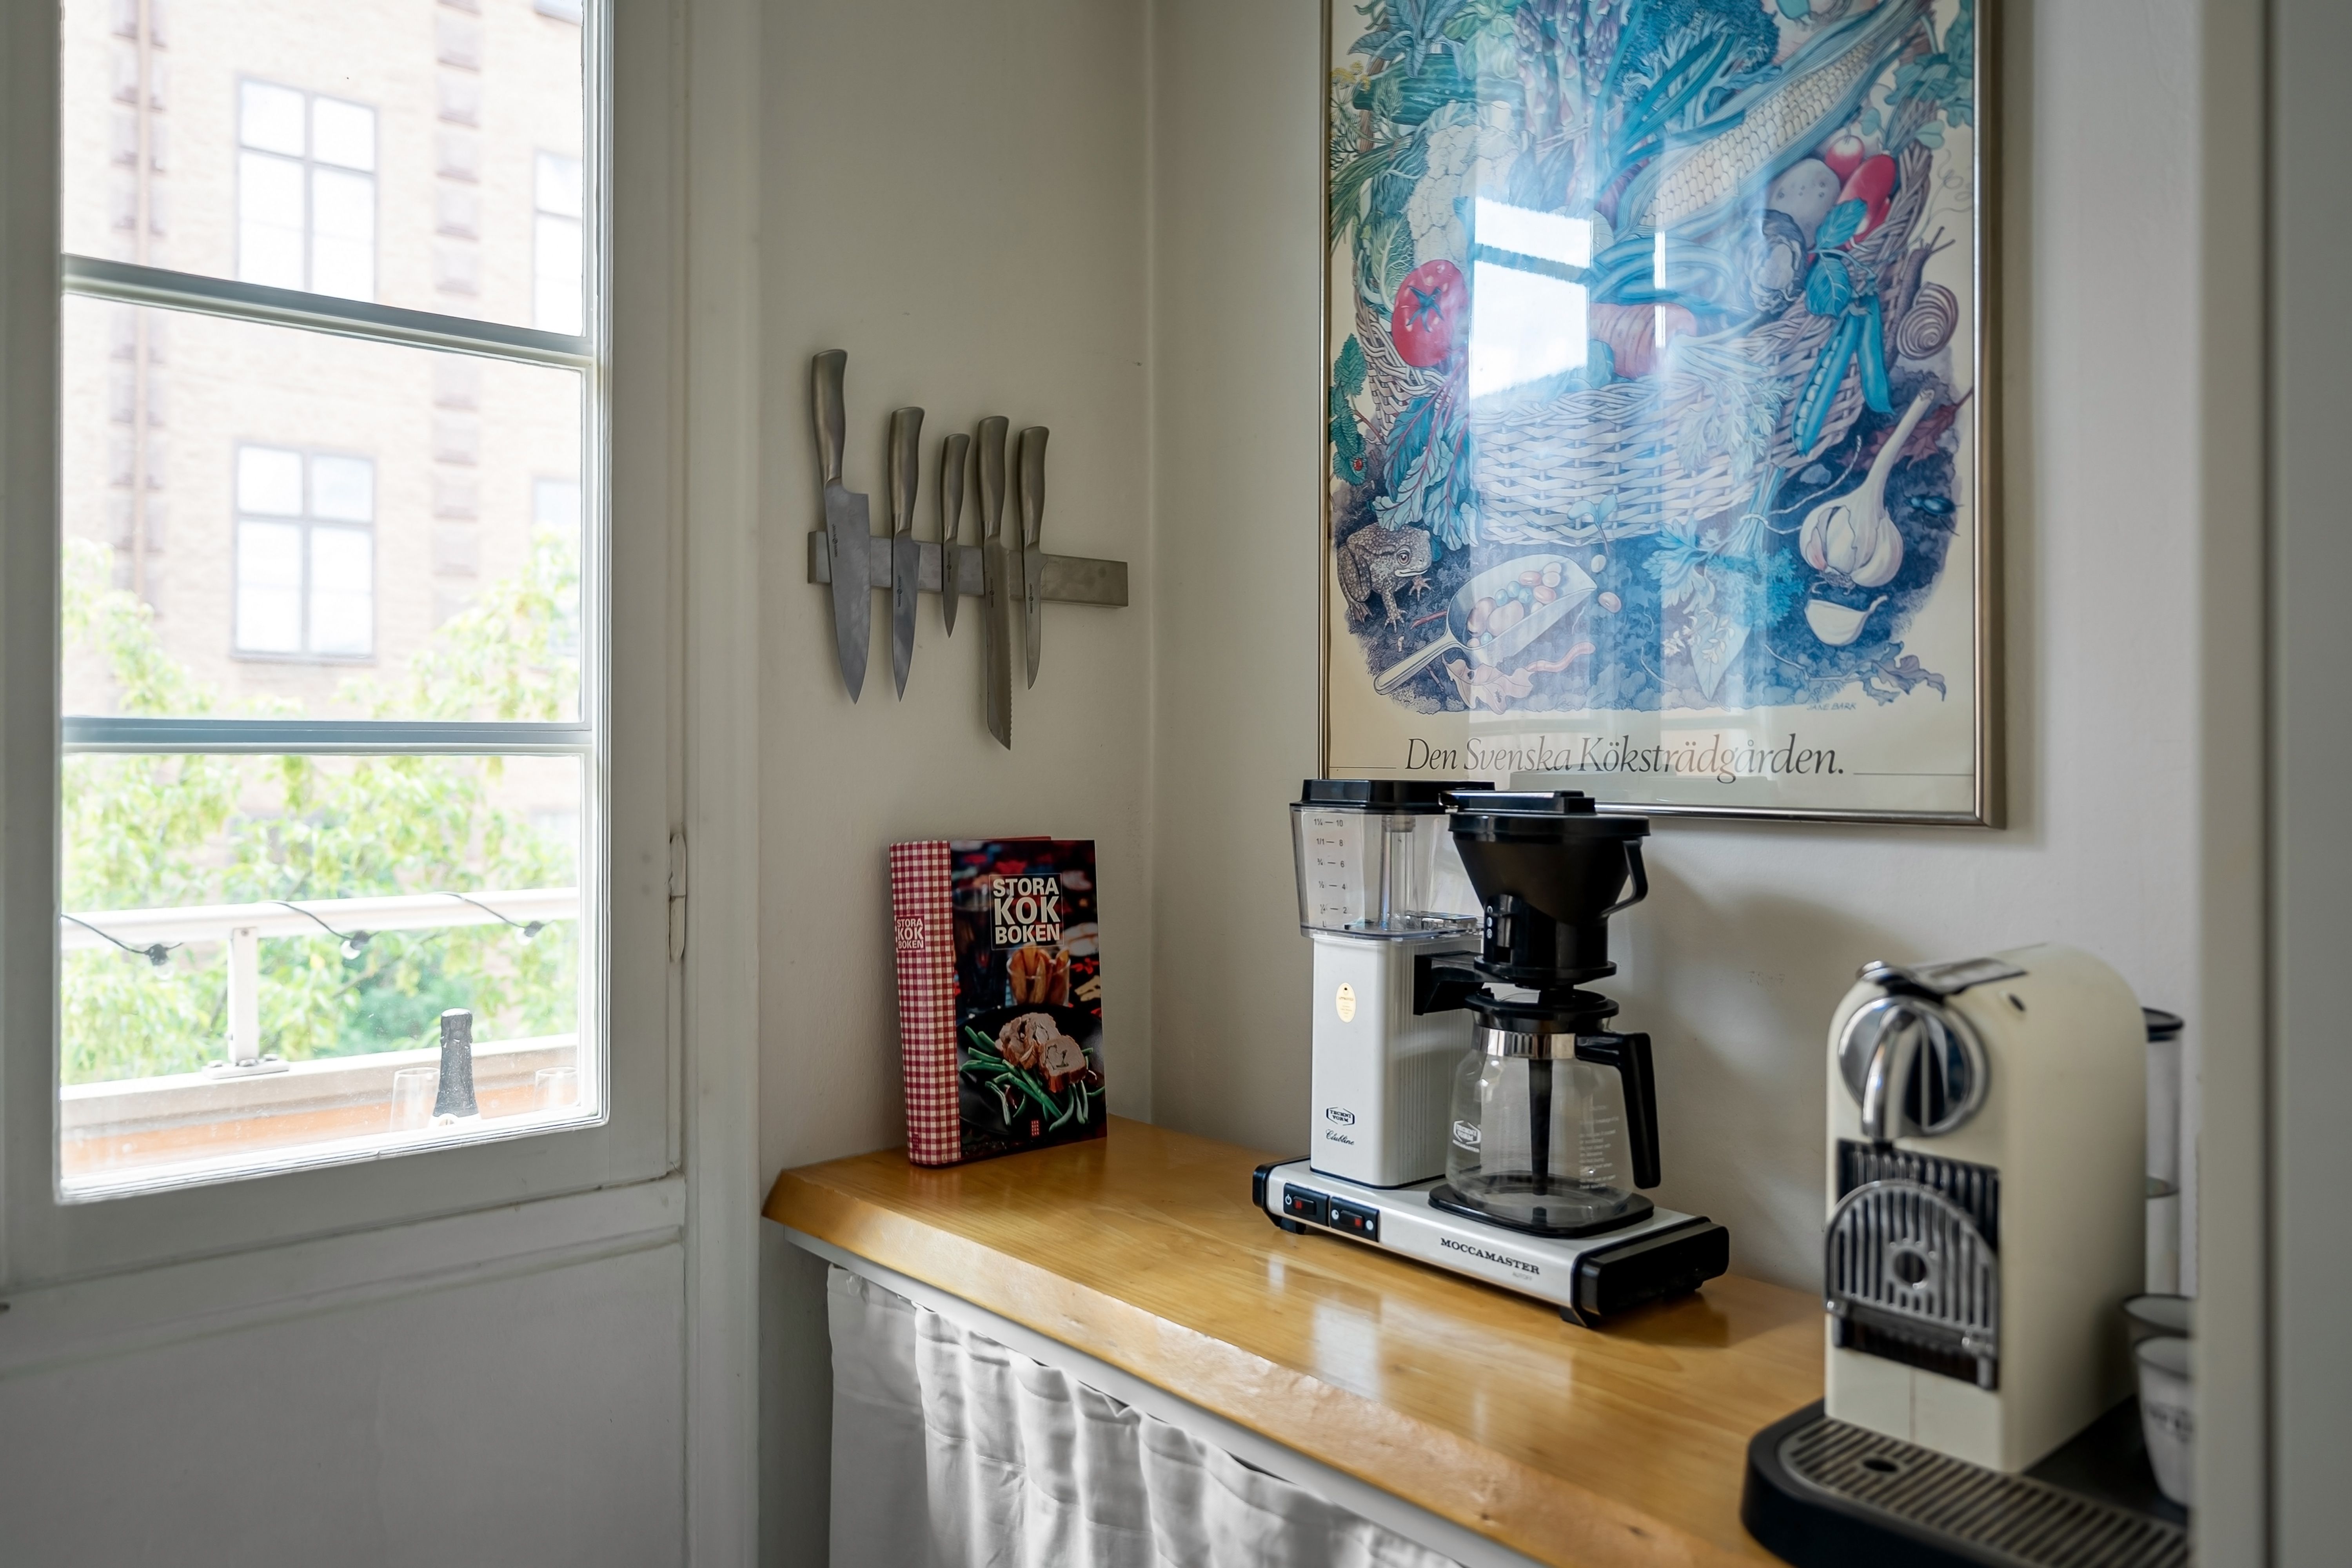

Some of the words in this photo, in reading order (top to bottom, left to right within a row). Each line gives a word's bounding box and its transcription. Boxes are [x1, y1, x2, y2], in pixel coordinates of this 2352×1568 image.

[1831, 702, 1857, 710] BARK
[1405, 738, 1458, 770] Den
[1463, 735, 1573, 771] Svenska
[1577, 733, 1843, 784] Köksträdgården.
[993, 877, 1059, 897] STORA
[994, 896, 1061, 926] KOK
[897, 918, 923, 928] STORA
[898, 926, 924, 940] KOK
[995, 924, 1060, 944] BOKEN
[898, 940, 924, 949] BOKEN
[1325, 1129, 1355, 1145] Clubline
[1440, 1238, 1540, 1275] MOCCAMASTER
